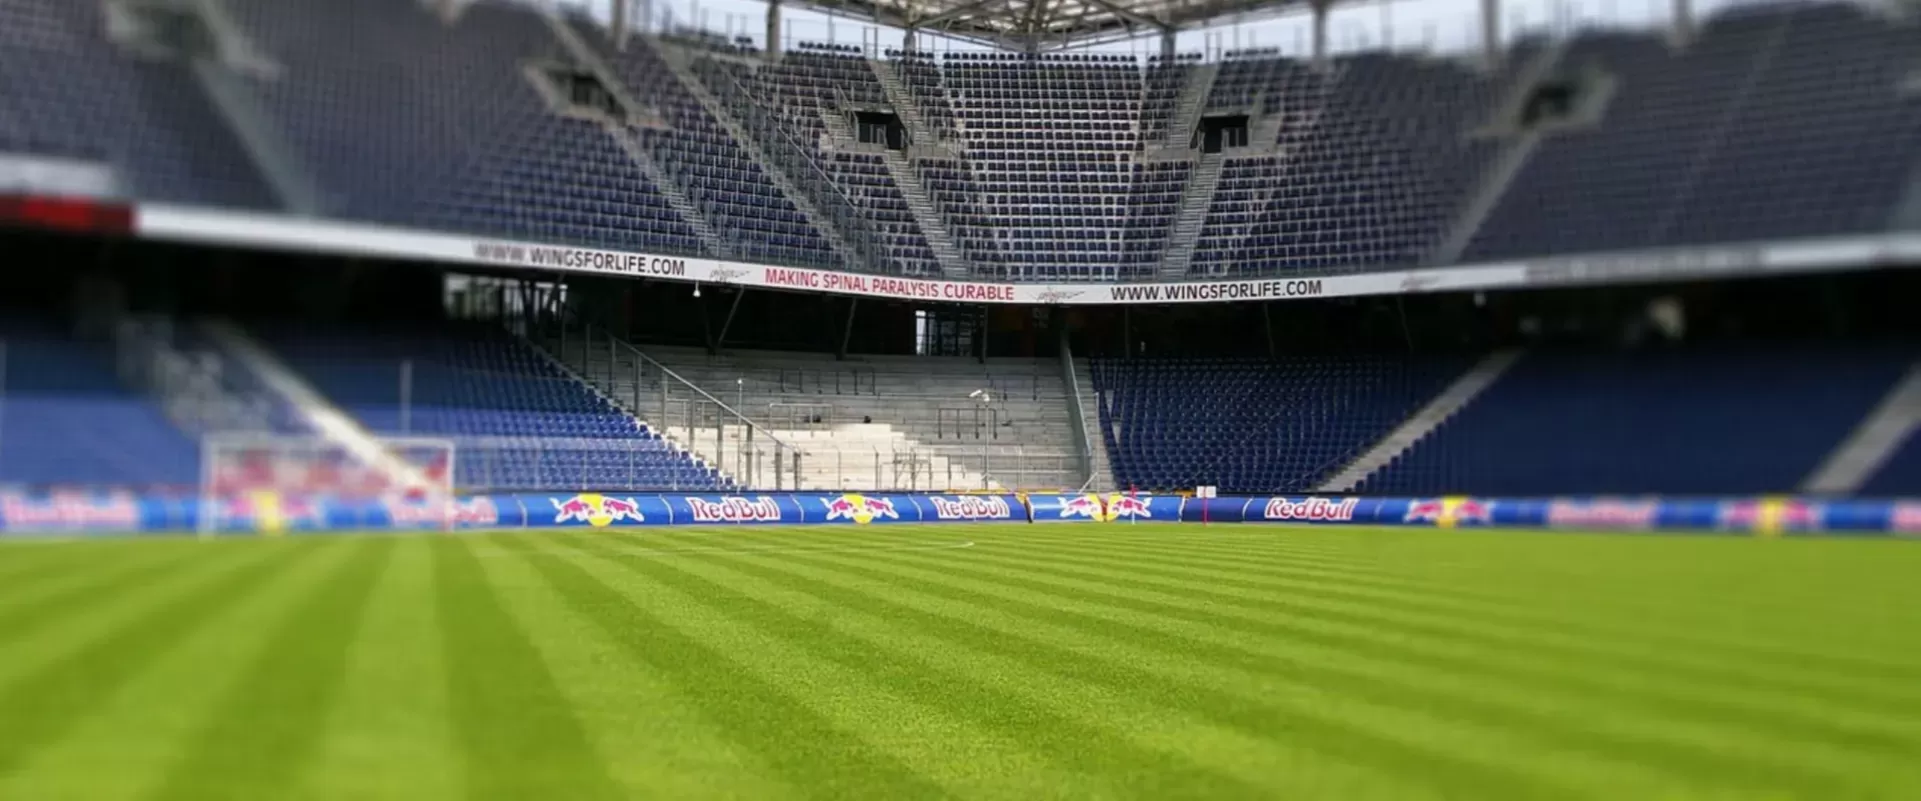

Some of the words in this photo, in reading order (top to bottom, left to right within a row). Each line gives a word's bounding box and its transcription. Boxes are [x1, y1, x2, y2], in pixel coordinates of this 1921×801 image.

[765, 268, 818, 287] MAKING
[823, 274, 868, 291] SPINAL
[872, 278, 939, 297] PARALYSIS
[944, 284, 1015, 300] CURABLE
[1110, 280, 1322, 300] WWW.WINGSFORLIFE.COM
